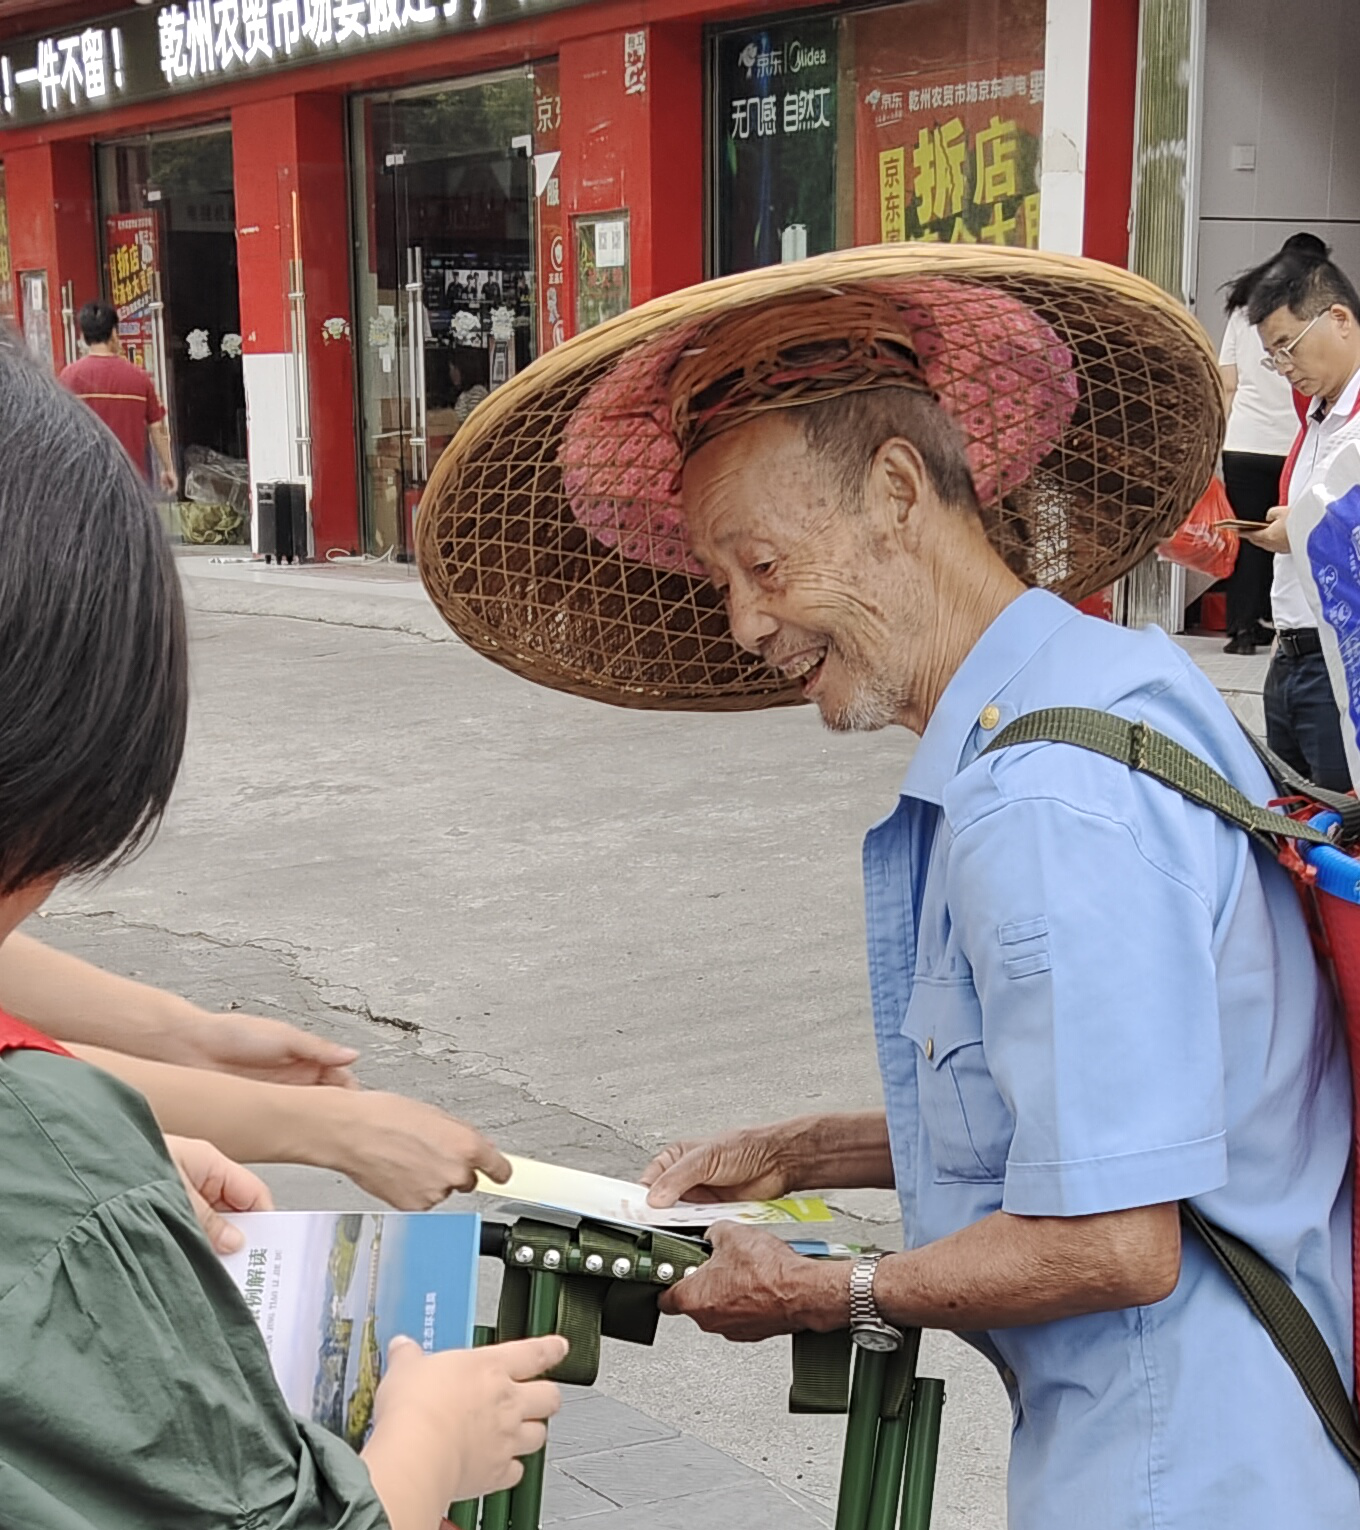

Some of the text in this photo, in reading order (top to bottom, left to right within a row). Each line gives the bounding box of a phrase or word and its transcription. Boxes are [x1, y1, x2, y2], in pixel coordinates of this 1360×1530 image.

[757, 50, 782, 78] 京东
[789, 41, 827, 73] Midea
[912, 115, 1019, 225] 拆店
[423, 1291, 437, 1355] 生态环境局
